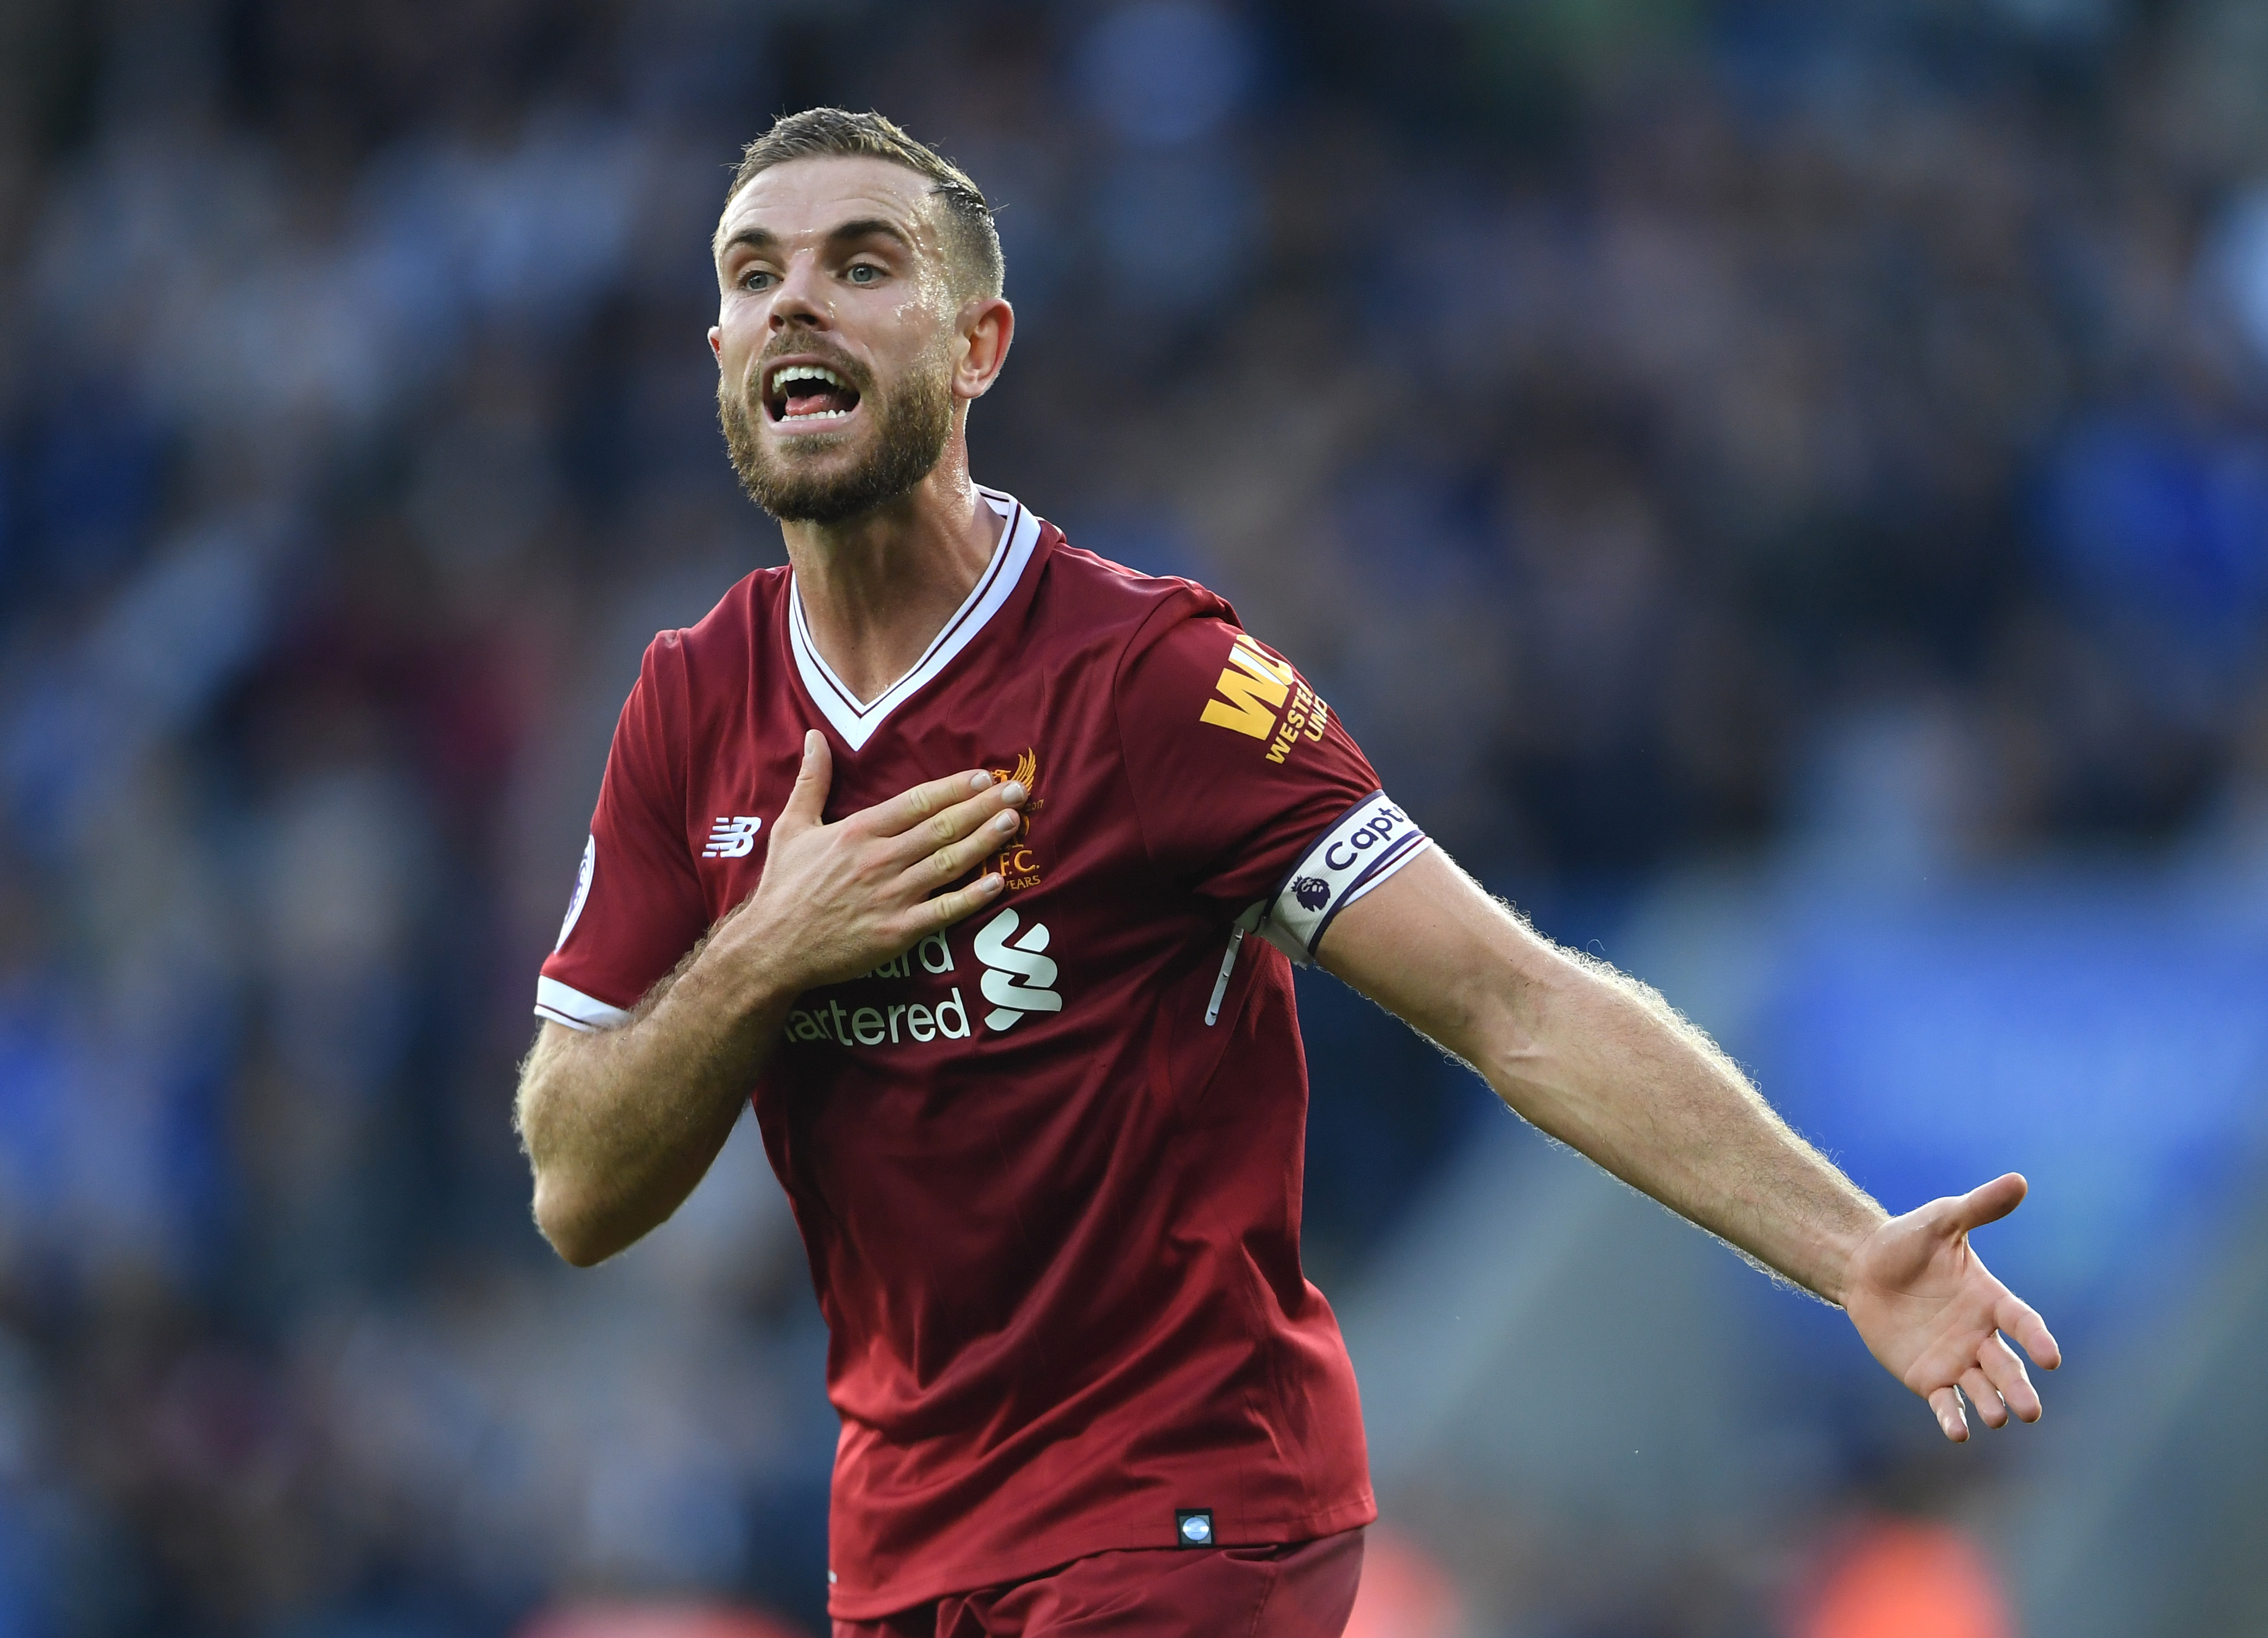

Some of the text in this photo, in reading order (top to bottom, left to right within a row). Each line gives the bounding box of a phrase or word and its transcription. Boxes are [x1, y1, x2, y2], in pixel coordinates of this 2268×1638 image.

[1265, 679, 1313, 764] WESTE
[1026, 799, 1044, 812] 2017
[1325, 807, 1408, 871] Capt
